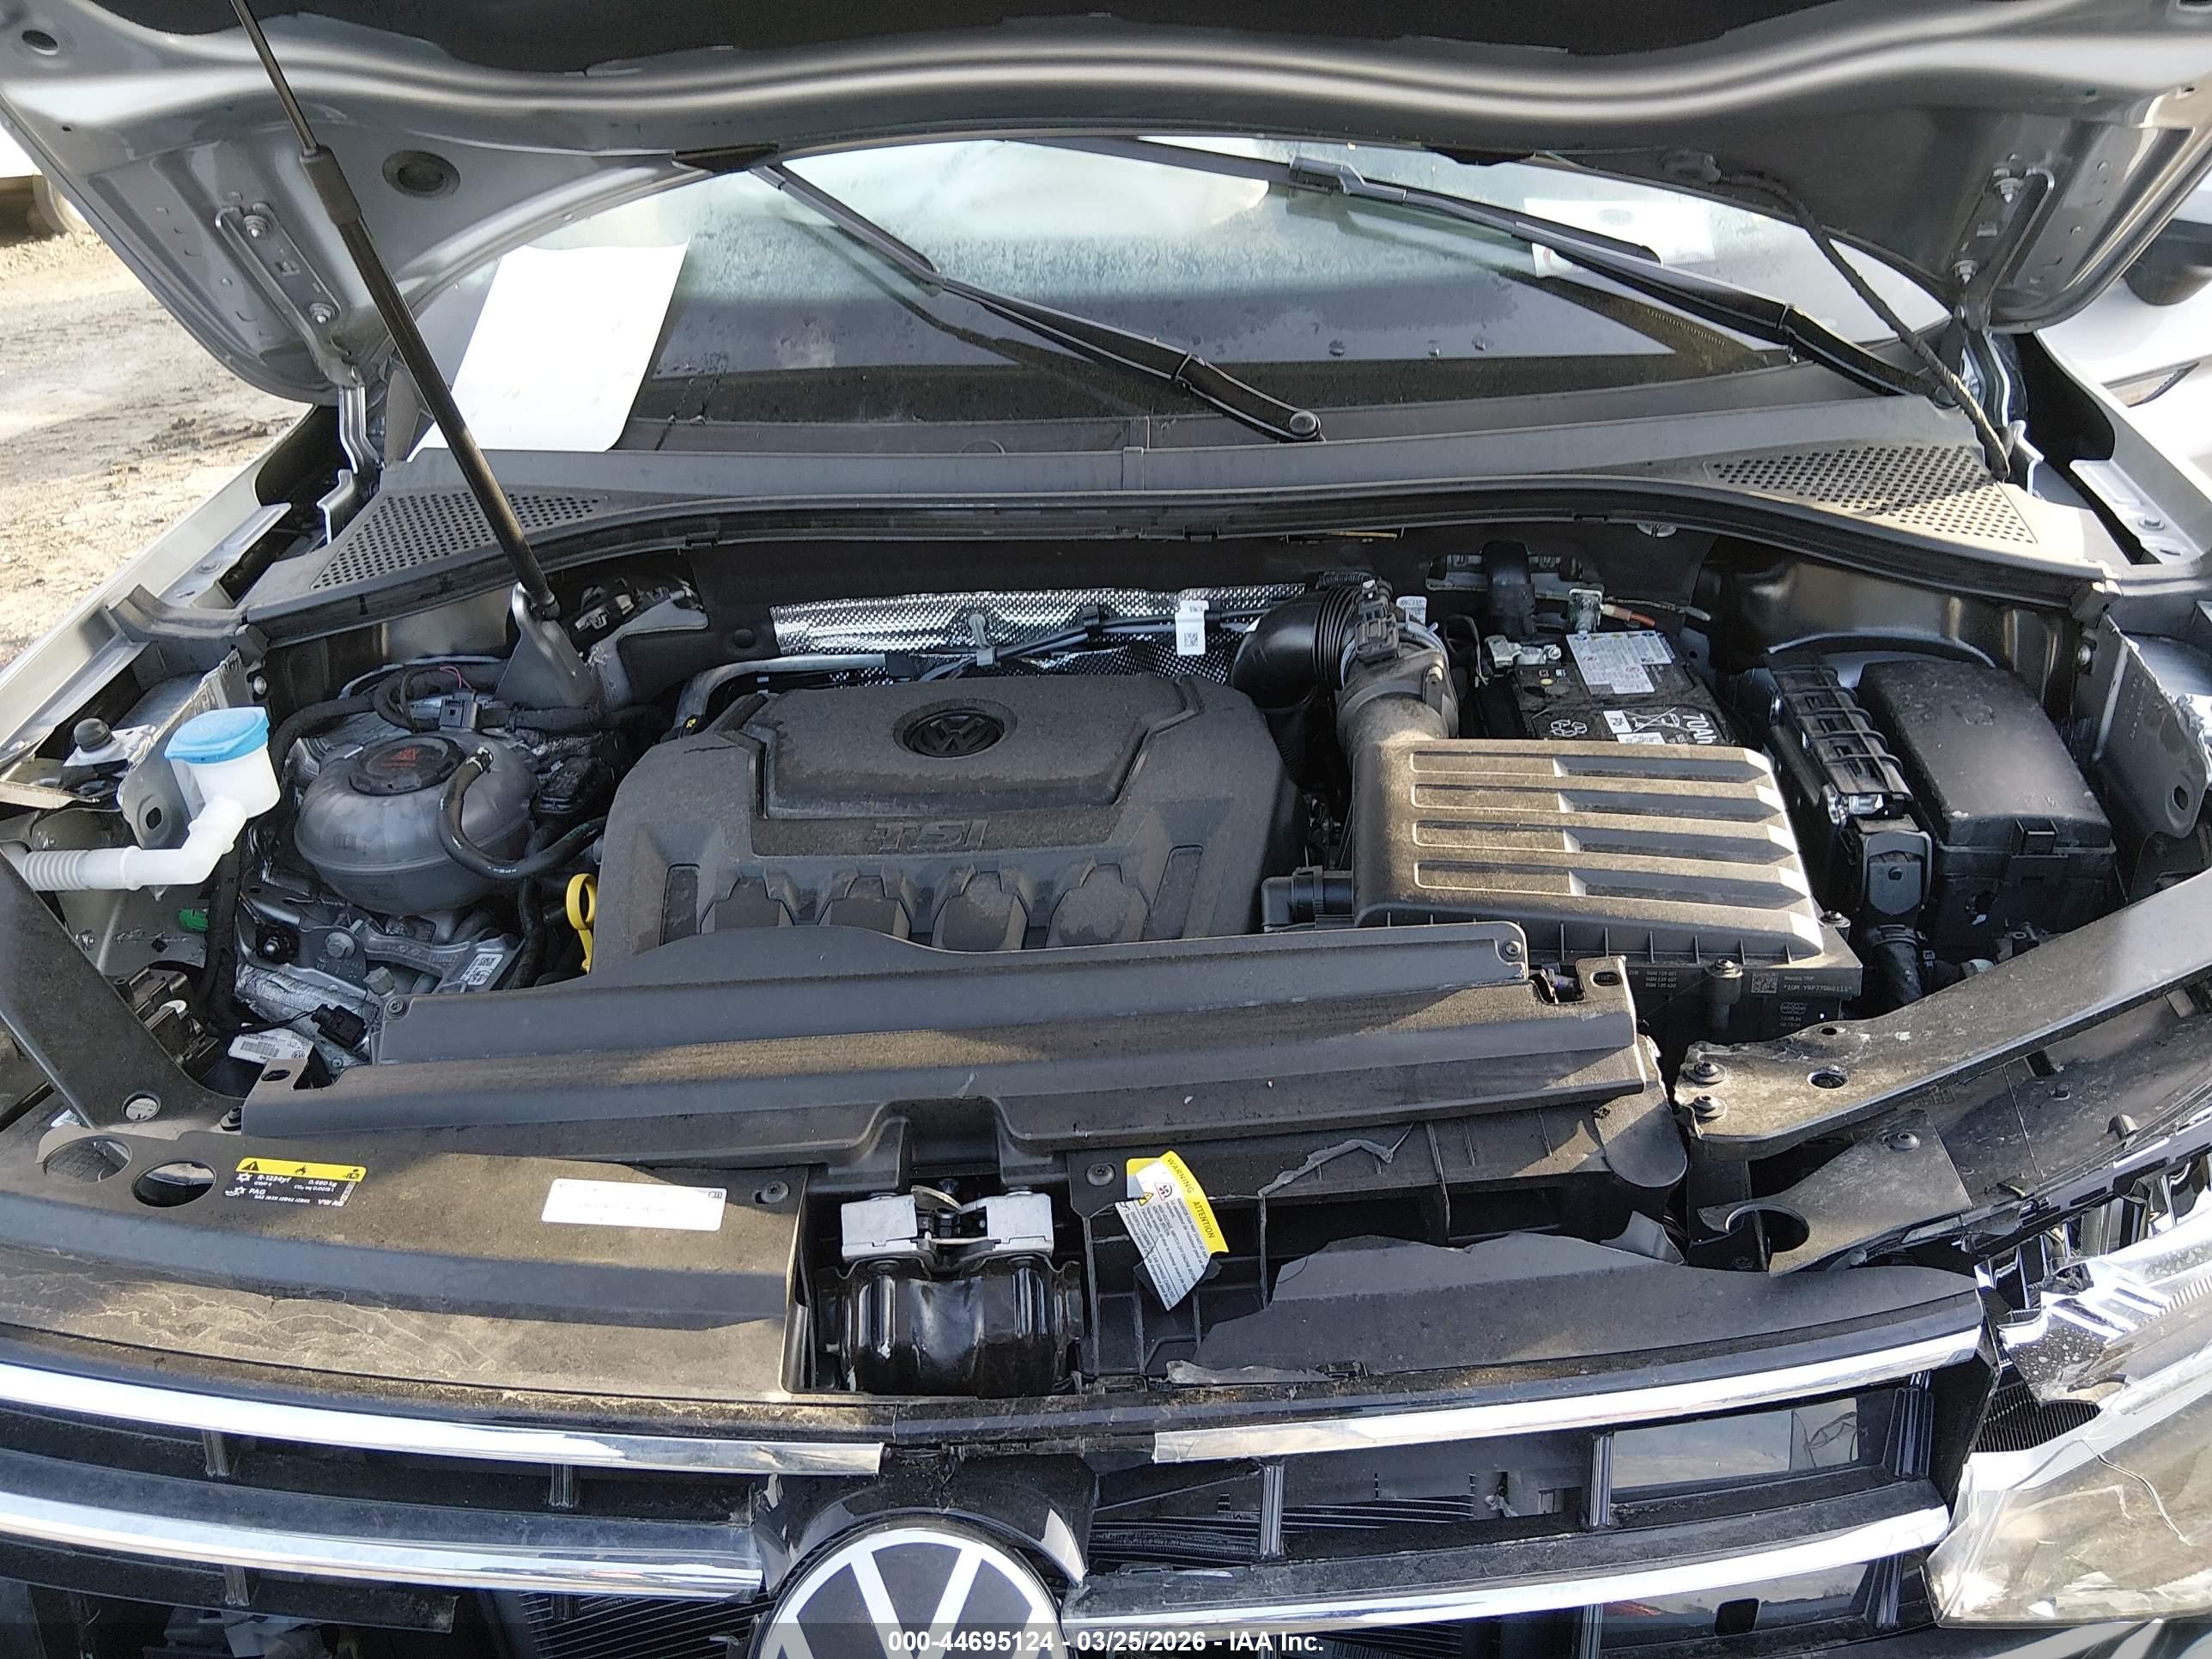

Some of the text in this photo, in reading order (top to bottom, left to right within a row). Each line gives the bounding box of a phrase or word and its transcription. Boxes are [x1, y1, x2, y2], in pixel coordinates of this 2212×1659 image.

[1682, 713, 1717, 744] 70Ah
[873, 819, 989, 853] TSI
[258, 1174, 292, 1184] R-1234yf
[1167, 1158, 1194, 1194] WARNING
[1192, 1200, 1216, 1240] ATTENTION
